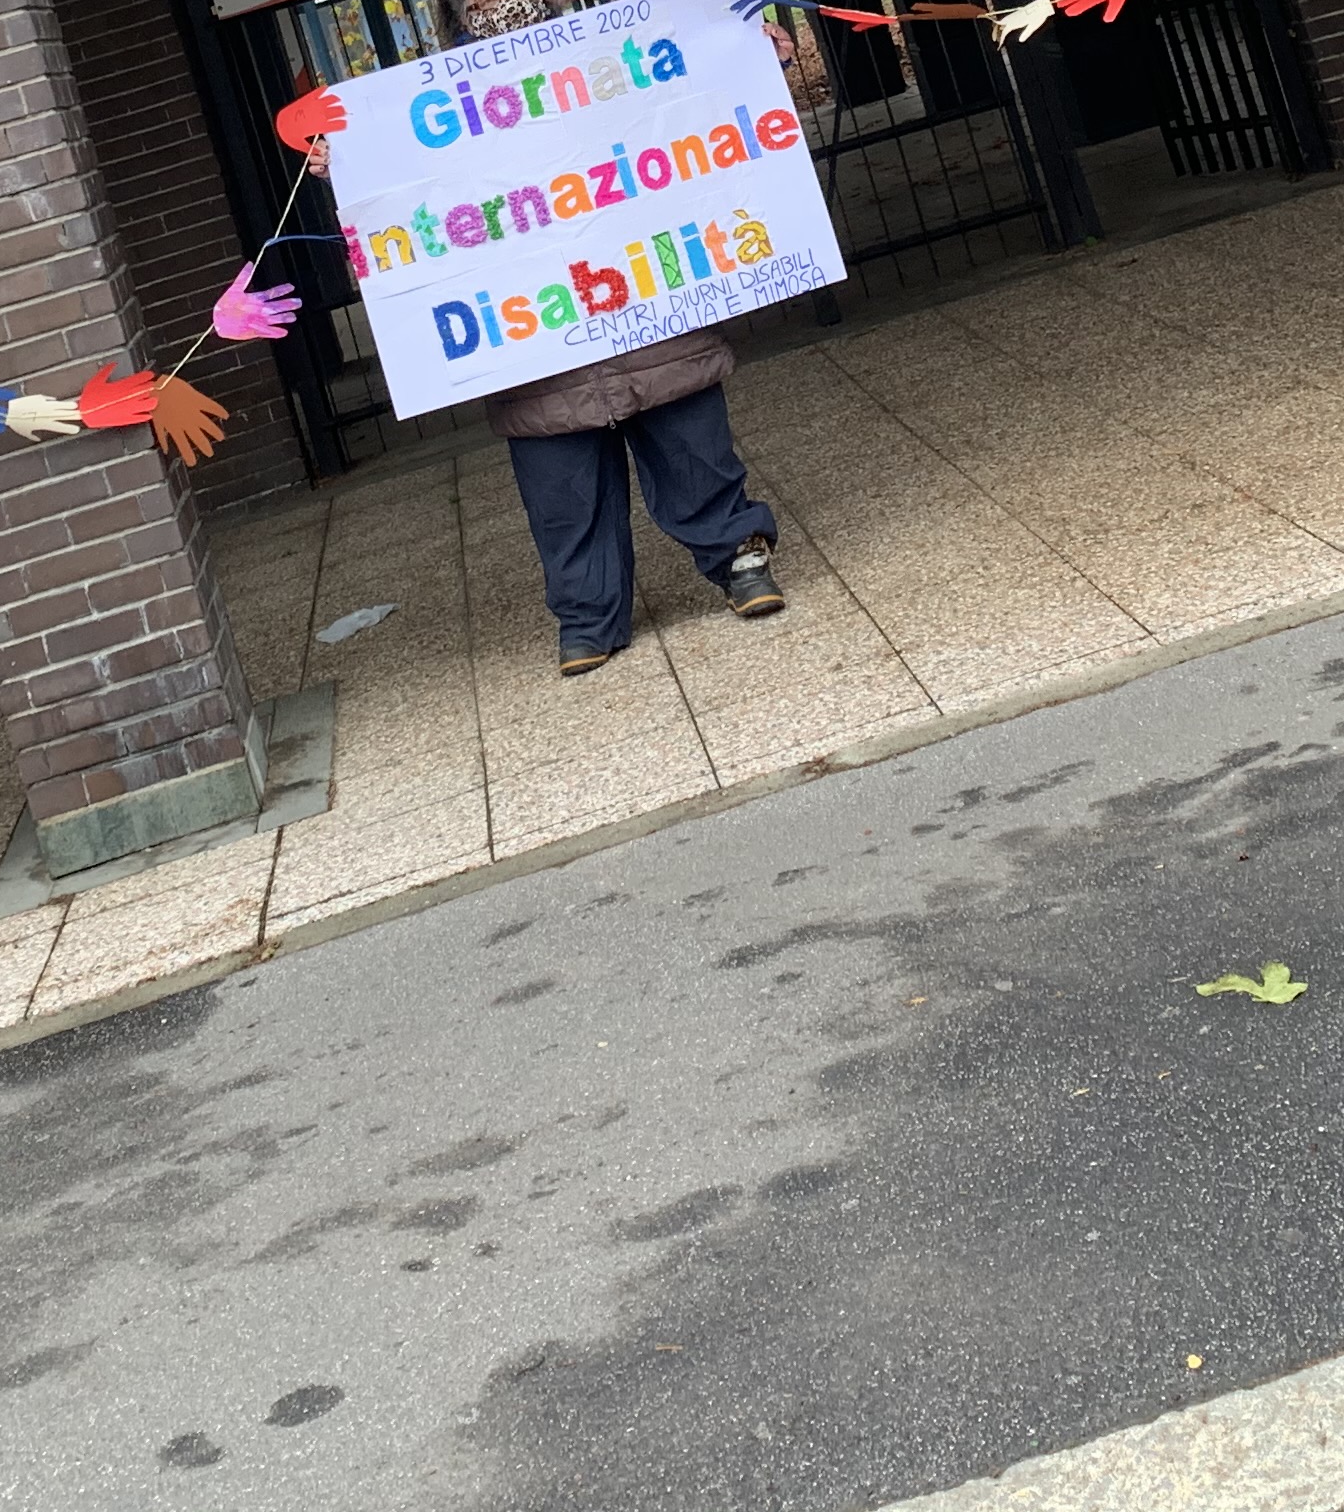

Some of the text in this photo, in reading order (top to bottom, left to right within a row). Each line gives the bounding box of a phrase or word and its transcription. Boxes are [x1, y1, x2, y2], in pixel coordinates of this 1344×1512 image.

[409, 34, 688, 149] Giornata
[420, 0, 651, 85] 3 DICEMBRE 2020
[431, 209, 774, 361] Disabilità
[564, 248, 815, 346] CENTRI DIURNI DISABILI
[612, 266, 828, 356] MAGNOLIA E MIMOSA
